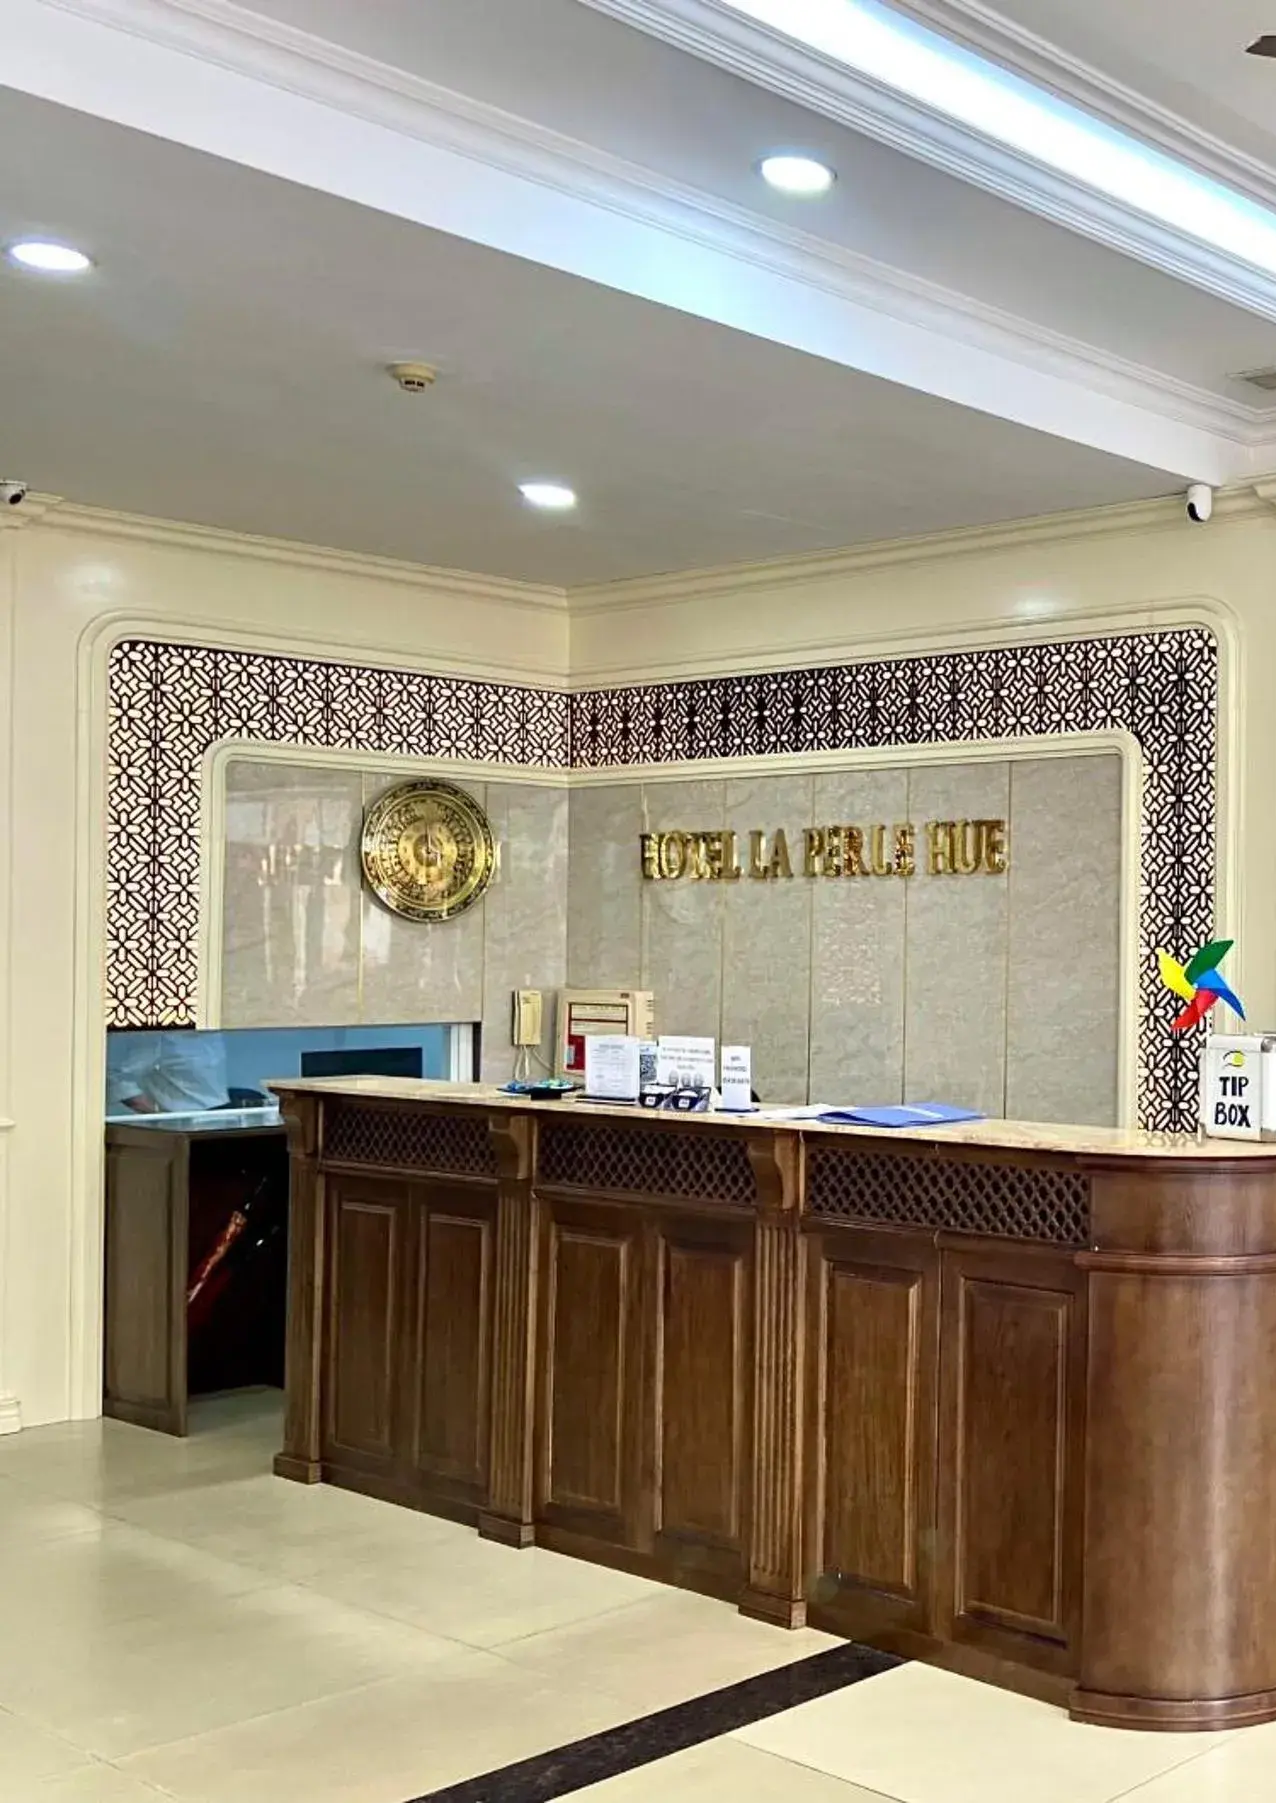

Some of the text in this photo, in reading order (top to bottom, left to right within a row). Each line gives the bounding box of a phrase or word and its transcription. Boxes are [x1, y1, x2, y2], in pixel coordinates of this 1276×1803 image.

[639, 819, 1008, 880] HOTEL LA PERLE HUE
[1218, 1076, 1249, 1097] TIP
[1214, 1101, 1252, 1128] BOX
